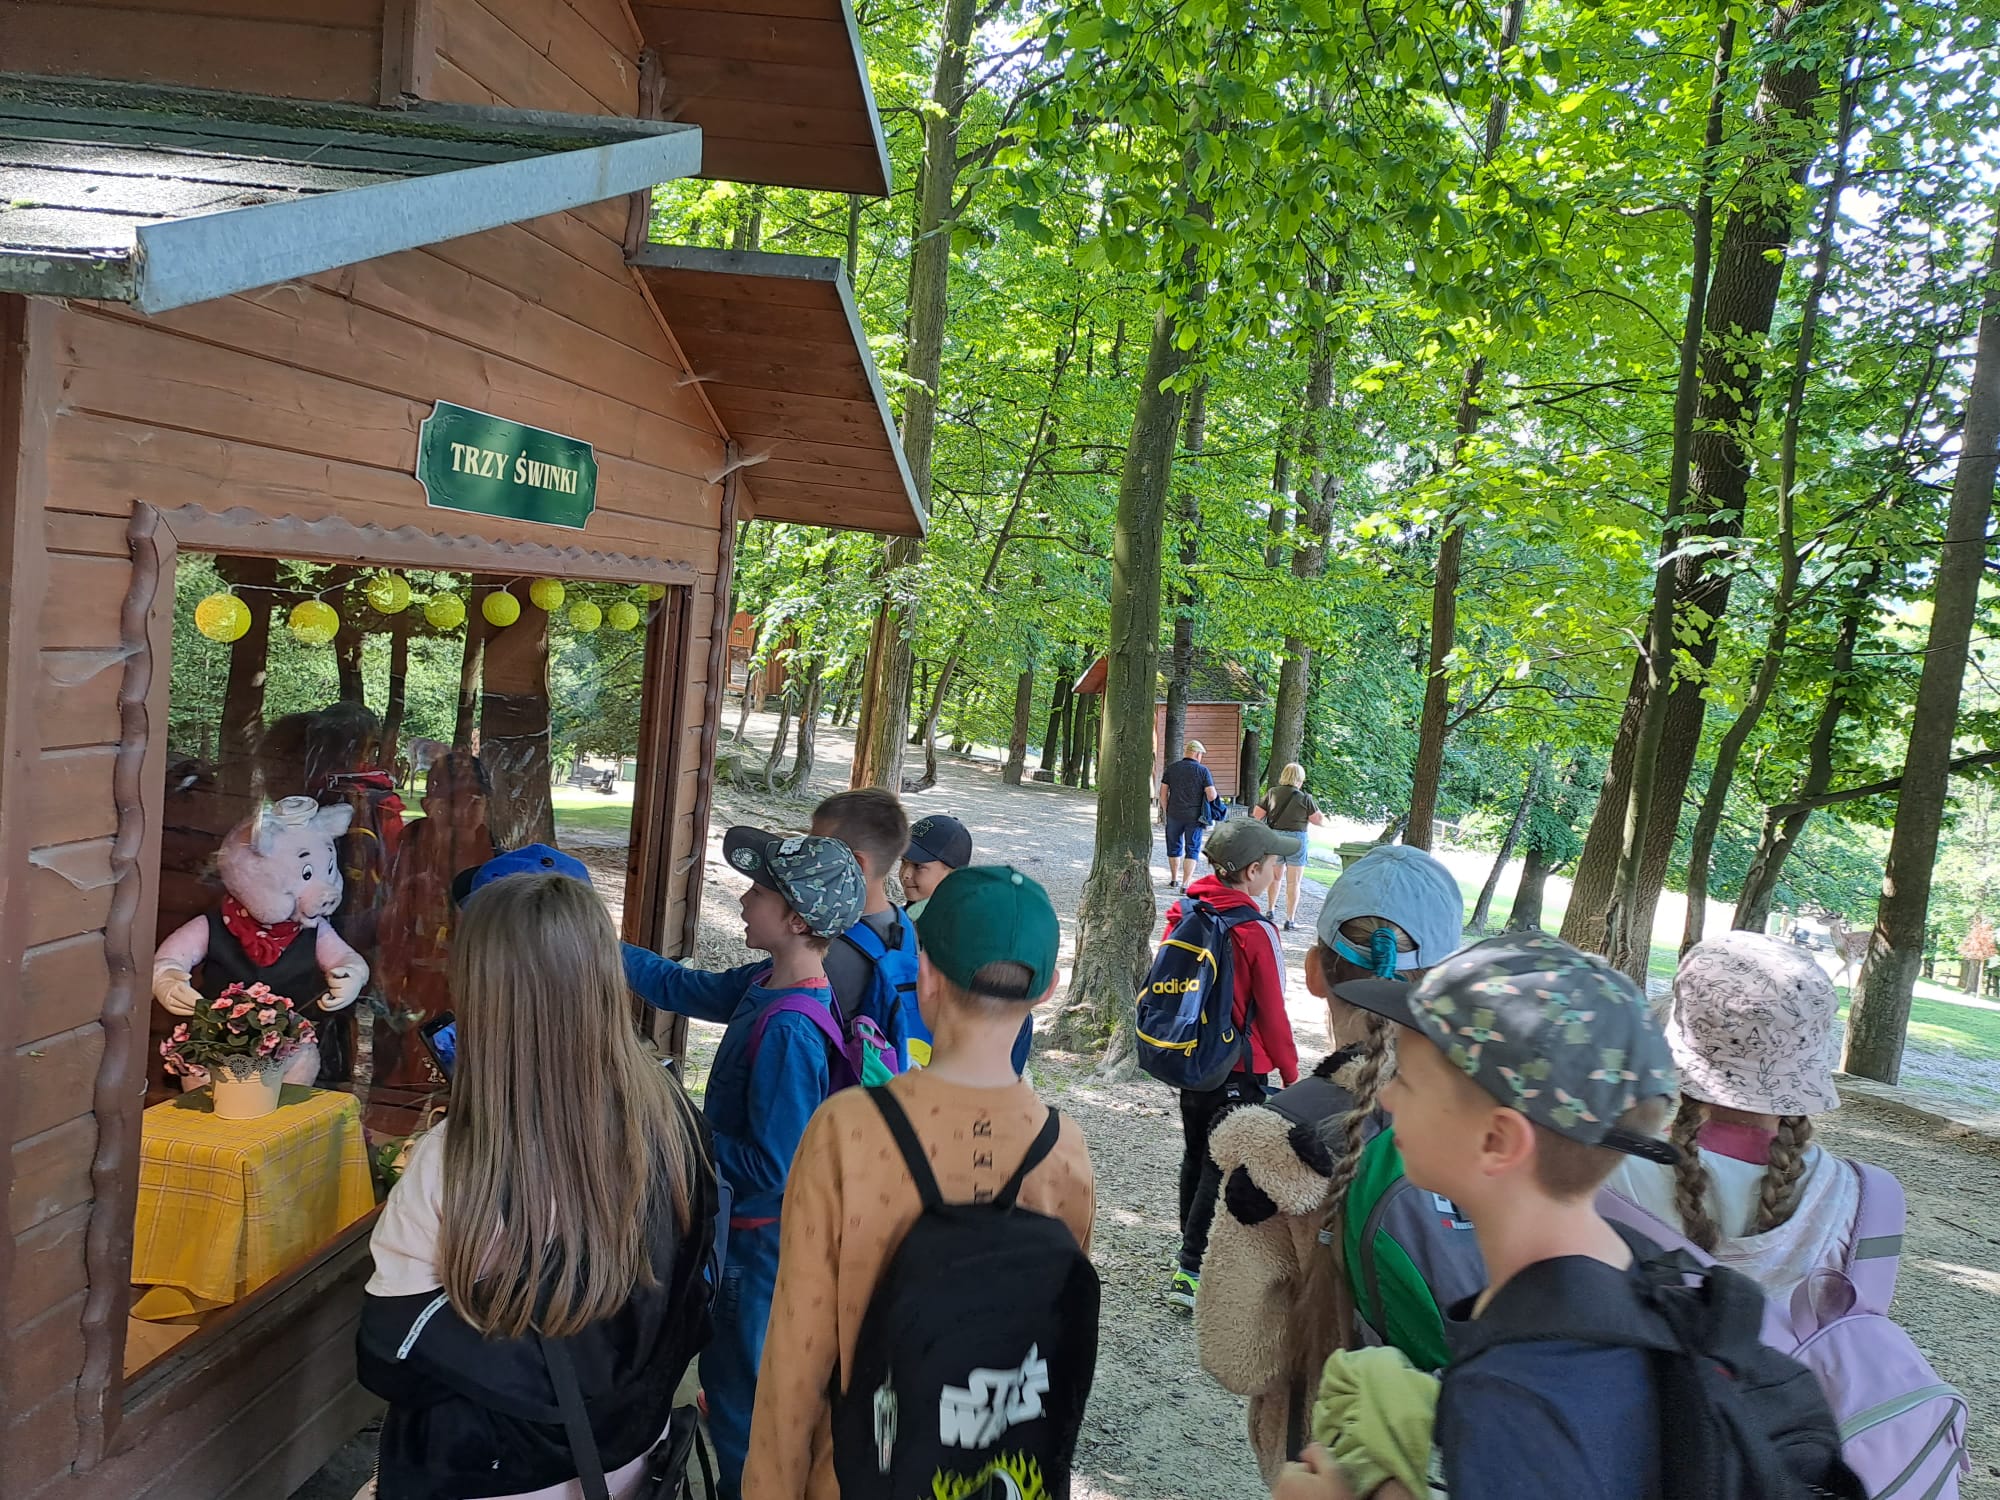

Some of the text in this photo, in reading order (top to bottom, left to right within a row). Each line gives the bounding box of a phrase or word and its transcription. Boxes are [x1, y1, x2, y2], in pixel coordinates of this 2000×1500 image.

[450, 442, 578, 495] TRZY ŚWINKI
[1152, 977, 1200, 994] adida
